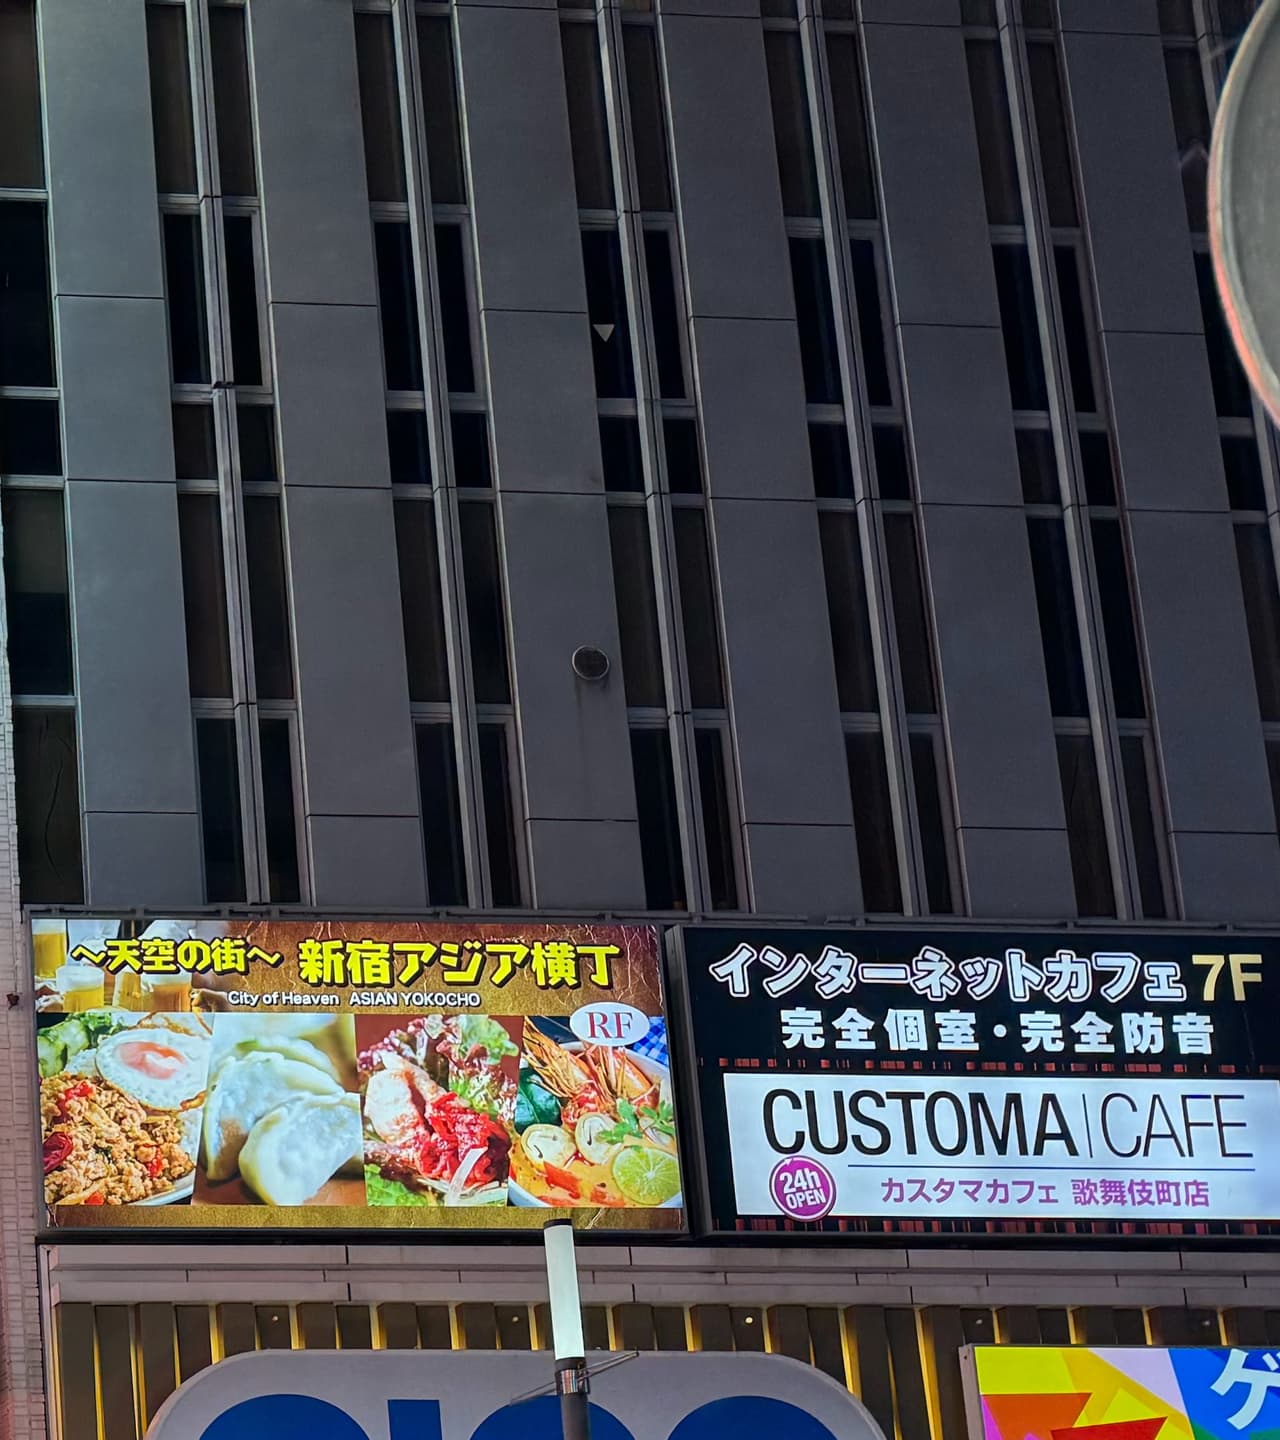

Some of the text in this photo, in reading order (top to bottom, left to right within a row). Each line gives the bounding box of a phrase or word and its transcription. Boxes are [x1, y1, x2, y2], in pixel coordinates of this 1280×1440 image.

[299, 939, 622, 988] 新宿アジア横丁
[710, 944, 1263, 1001] インターネットカフェ 7F
[228, 991, 481, 1008] City of Heaven ASIAN YOKOCHO
[587, 1011, 634, 1039] RF
[781, 1008, 1215, 1054] 完全個室・完全防音
[763, 1088, 1254, 1159] CUSTOMA CAFE
[779, 1168, 821, 1194] 24h
[881, 1177, 1210, 1208] カスタマカフェ 歌舞伎町店
[785, 1187, 827, 1209] OPEN
